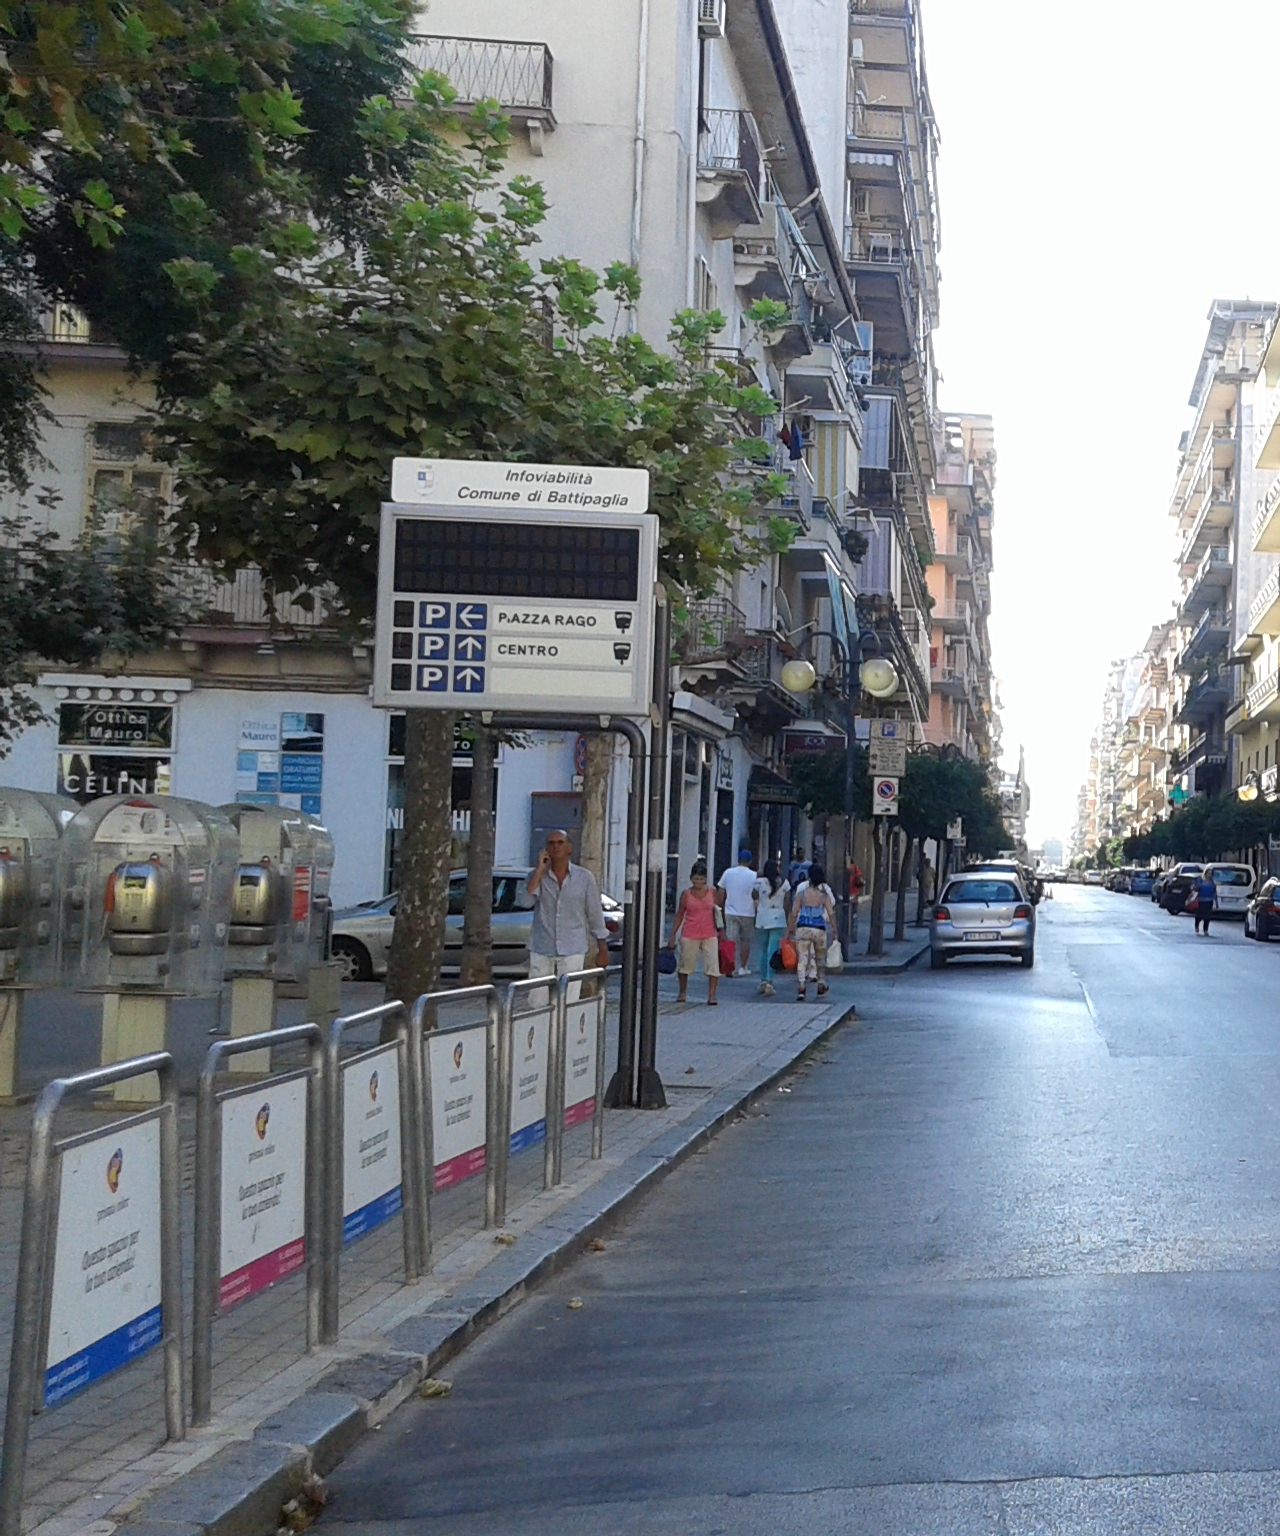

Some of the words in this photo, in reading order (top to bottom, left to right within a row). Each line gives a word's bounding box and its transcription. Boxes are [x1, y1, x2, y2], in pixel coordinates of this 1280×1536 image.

[505, 469, 593, 485] Infoviabilità
[457, 486, 520, 501] Comune
[527, 490, 542, 503] di
[547, 491, 629, 507] Battipaglia
[425, 604, 446, 625] P
[555, 614, 597, 627] RAGO
[423, 636, 444, 657] P
[497, 643, 559, 657] CENTRO
[422, 667, 443, 688] P
[95, 711, 147, 724] Ottica
[90, 727, 143, 739] Mauro
